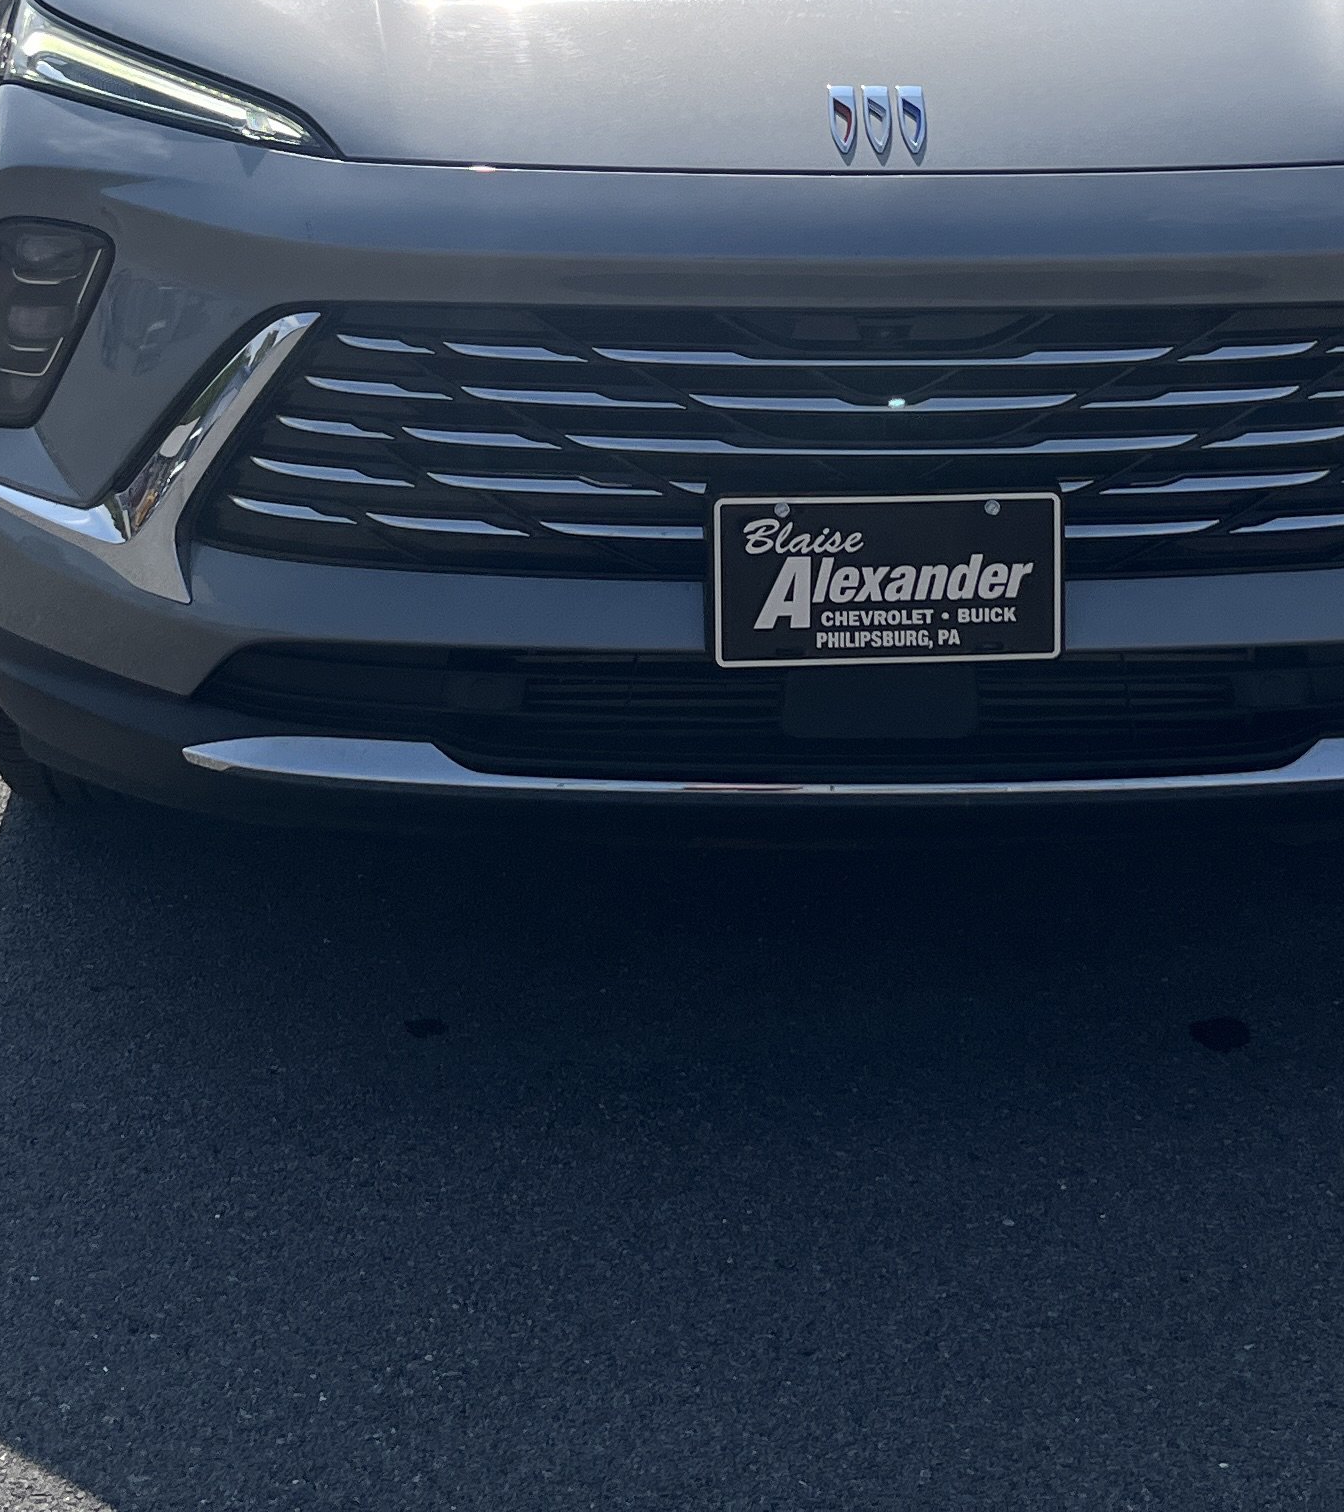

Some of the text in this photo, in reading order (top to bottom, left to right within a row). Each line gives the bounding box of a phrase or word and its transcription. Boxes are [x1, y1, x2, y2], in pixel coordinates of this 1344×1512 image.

[743, 518, 864, 555] Blaise
[753, 553, 1034, 630] Alexander
[821, 606, 1017, 627] CHEVROLET BUICK
[816, 629, 961, 649] PHILIPSBURG, PA
